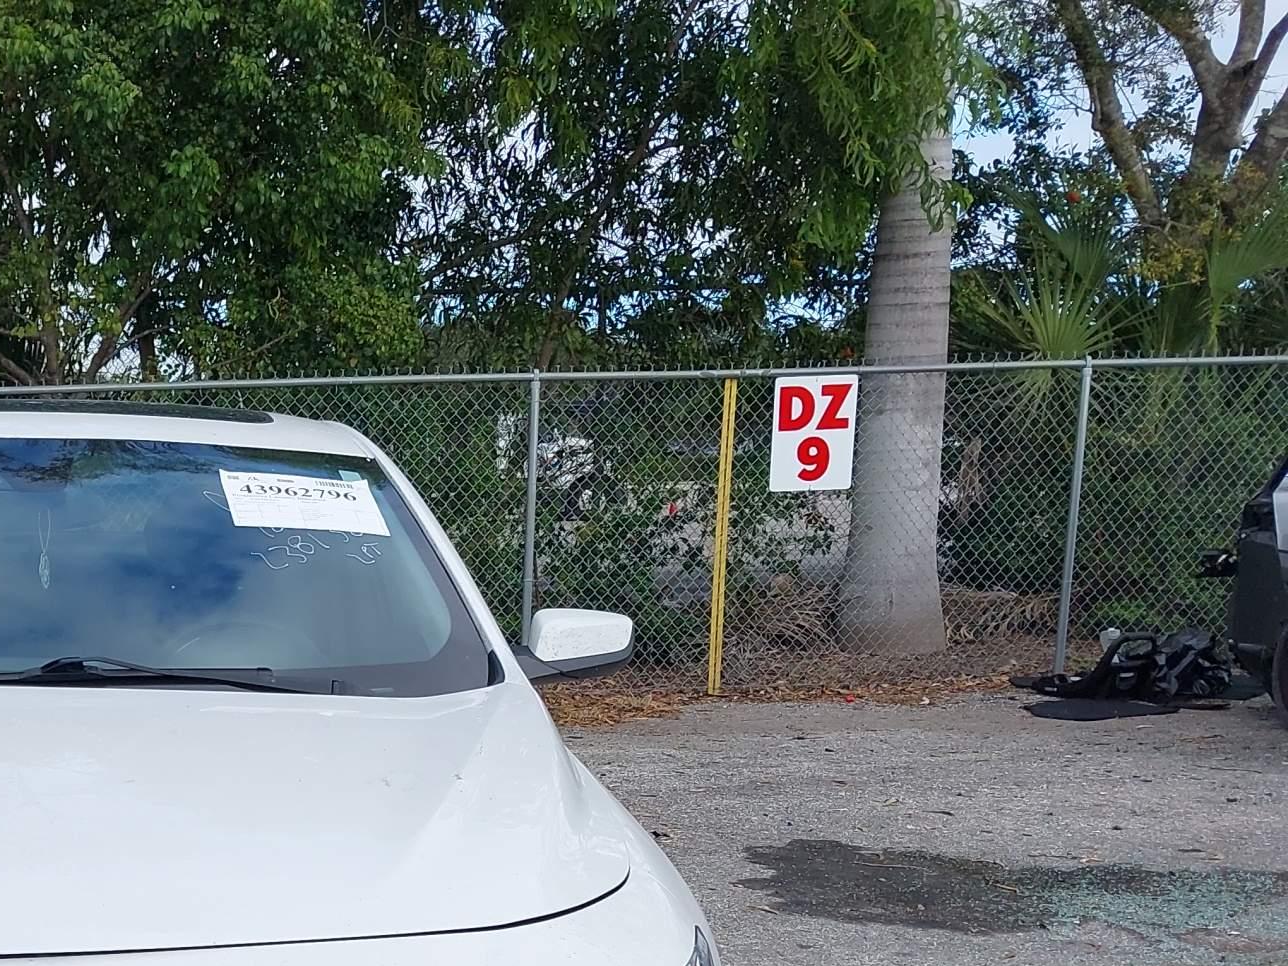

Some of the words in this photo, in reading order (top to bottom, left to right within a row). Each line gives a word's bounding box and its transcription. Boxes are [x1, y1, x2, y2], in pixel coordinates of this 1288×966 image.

[778, 383, 853, 432] DZ
[797, 436, 830, 482] 9
[238, 483, 358, 502] 43962796
